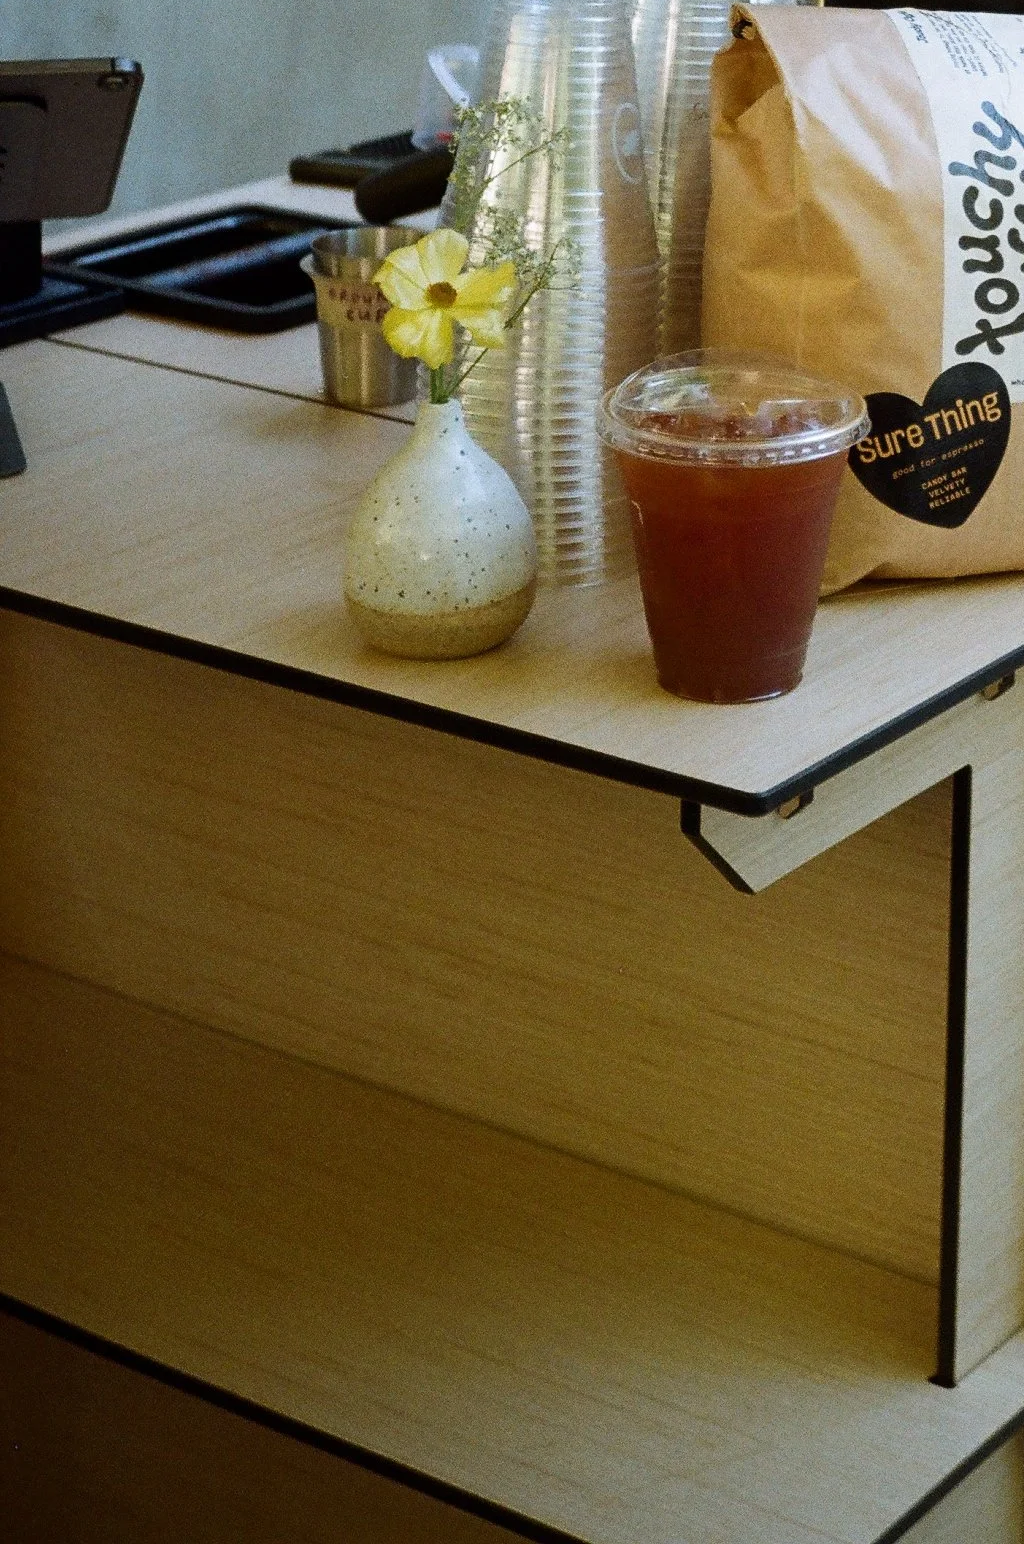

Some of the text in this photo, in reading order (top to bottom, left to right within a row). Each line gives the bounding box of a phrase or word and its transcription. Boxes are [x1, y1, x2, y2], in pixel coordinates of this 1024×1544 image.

[855, 391, 1002, 464] Sure Thing
[892, 438, 985, 480] good for espresso
[921, 466, 968, 491] CANDY BAR
[928, 477, 966, 499] VELVETY
[929, 486, 971, 509] RELIABLE
